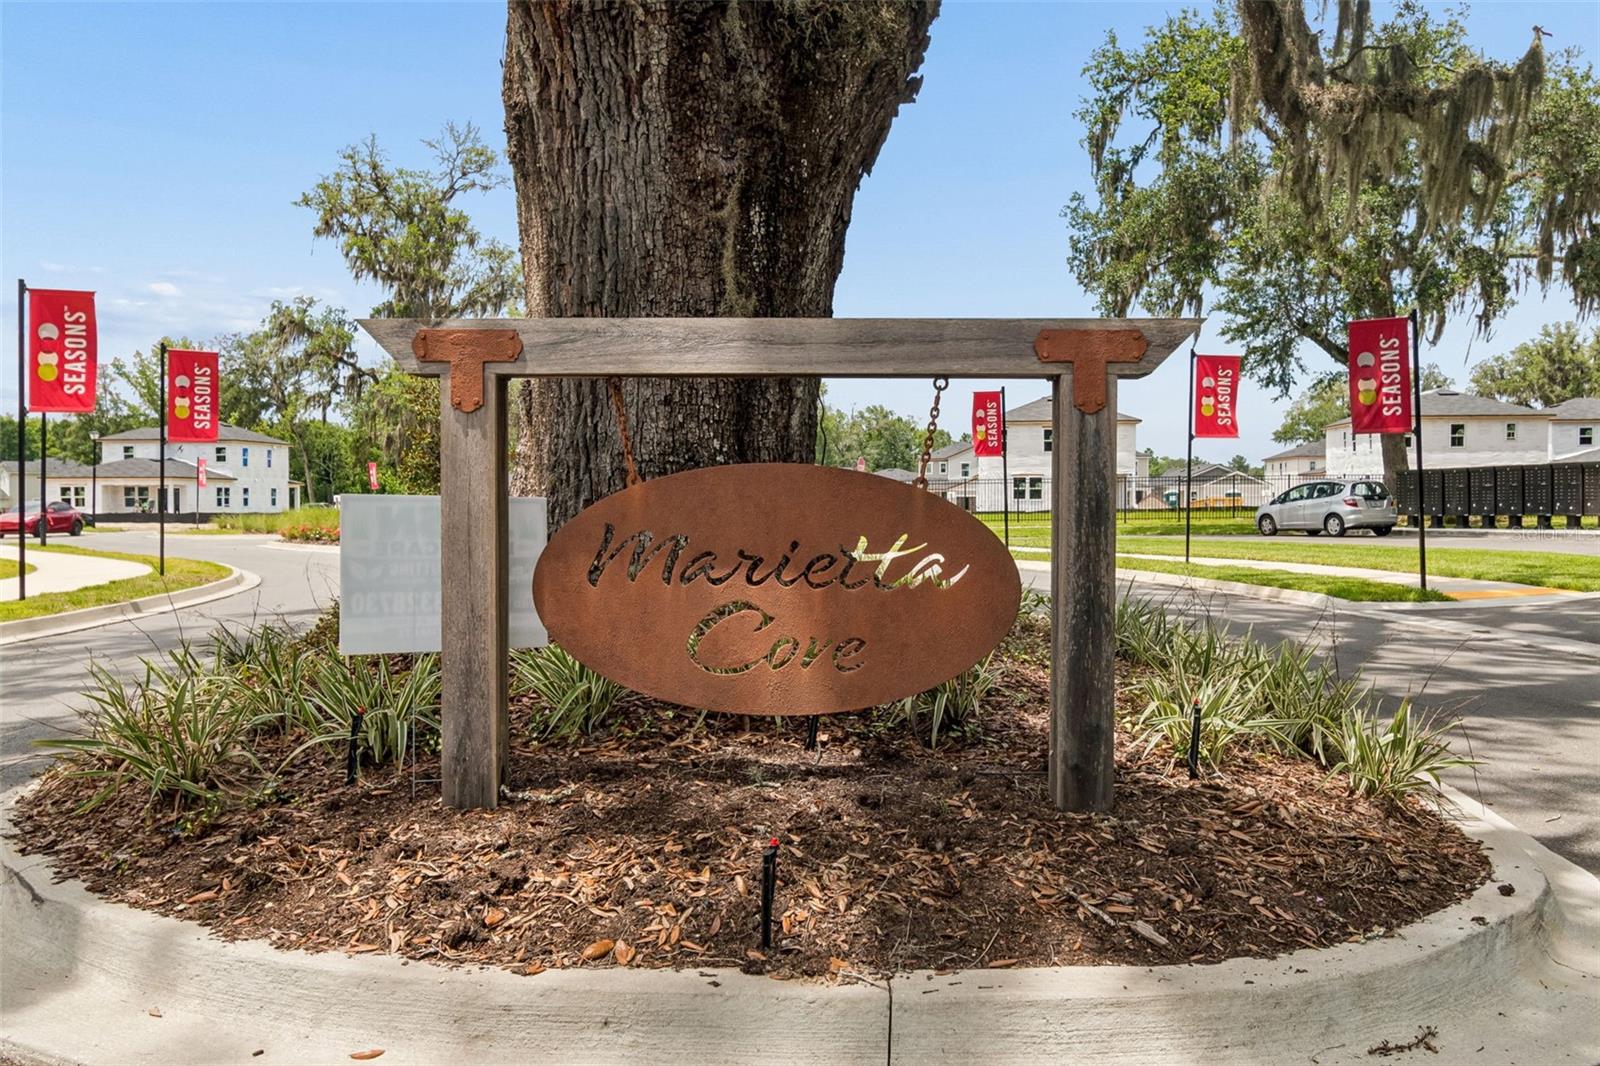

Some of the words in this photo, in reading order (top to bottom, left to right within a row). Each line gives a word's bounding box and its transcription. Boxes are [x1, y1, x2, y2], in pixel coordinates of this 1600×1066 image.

[63, 311, 87, 395] SEASONS
[1380, 337, 1402, 416] SEASONS
[193, 367, 211, 429] SEASONS
[986, 402, 998, 447] SEASONS
[1217, 369, 1233, 426] SEASONS
[586, 522, 970, 590] Marietta
[686, 600, 866, 676] Cove
